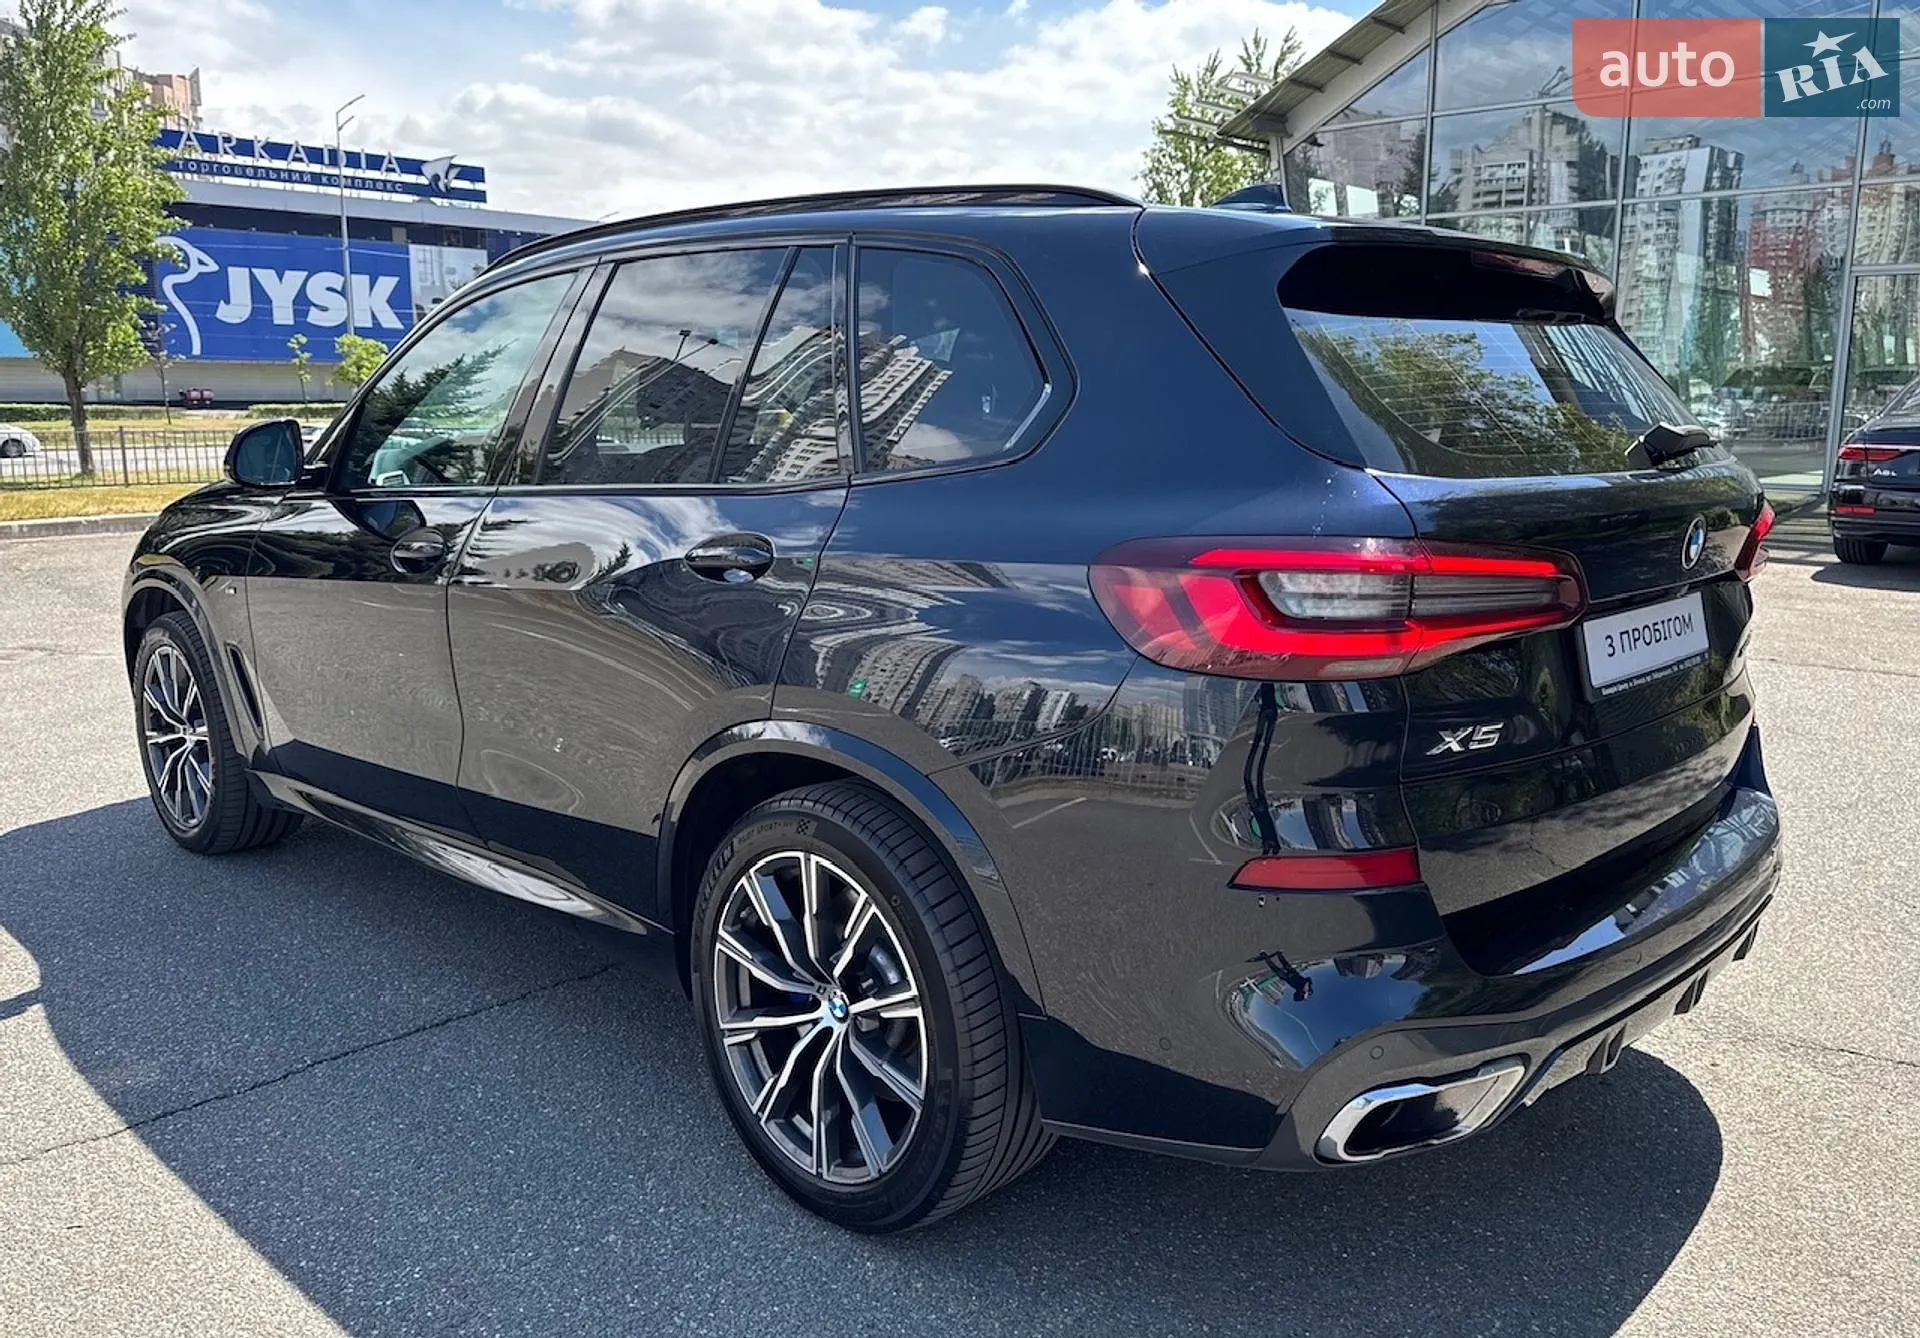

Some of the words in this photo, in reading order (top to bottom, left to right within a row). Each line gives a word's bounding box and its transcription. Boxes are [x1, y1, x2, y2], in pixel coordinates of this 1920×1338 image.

[177, 128, 402, 177] ARKADIA
[175, 159, 312, 183] торговельний
[321, 174, 404, 192] комплекс
[215, 266, 404, 329] JYSK
[1619, 612, 1694, 654] ПРОБІГОМ
[1425, 721, 1504, 756] X5
